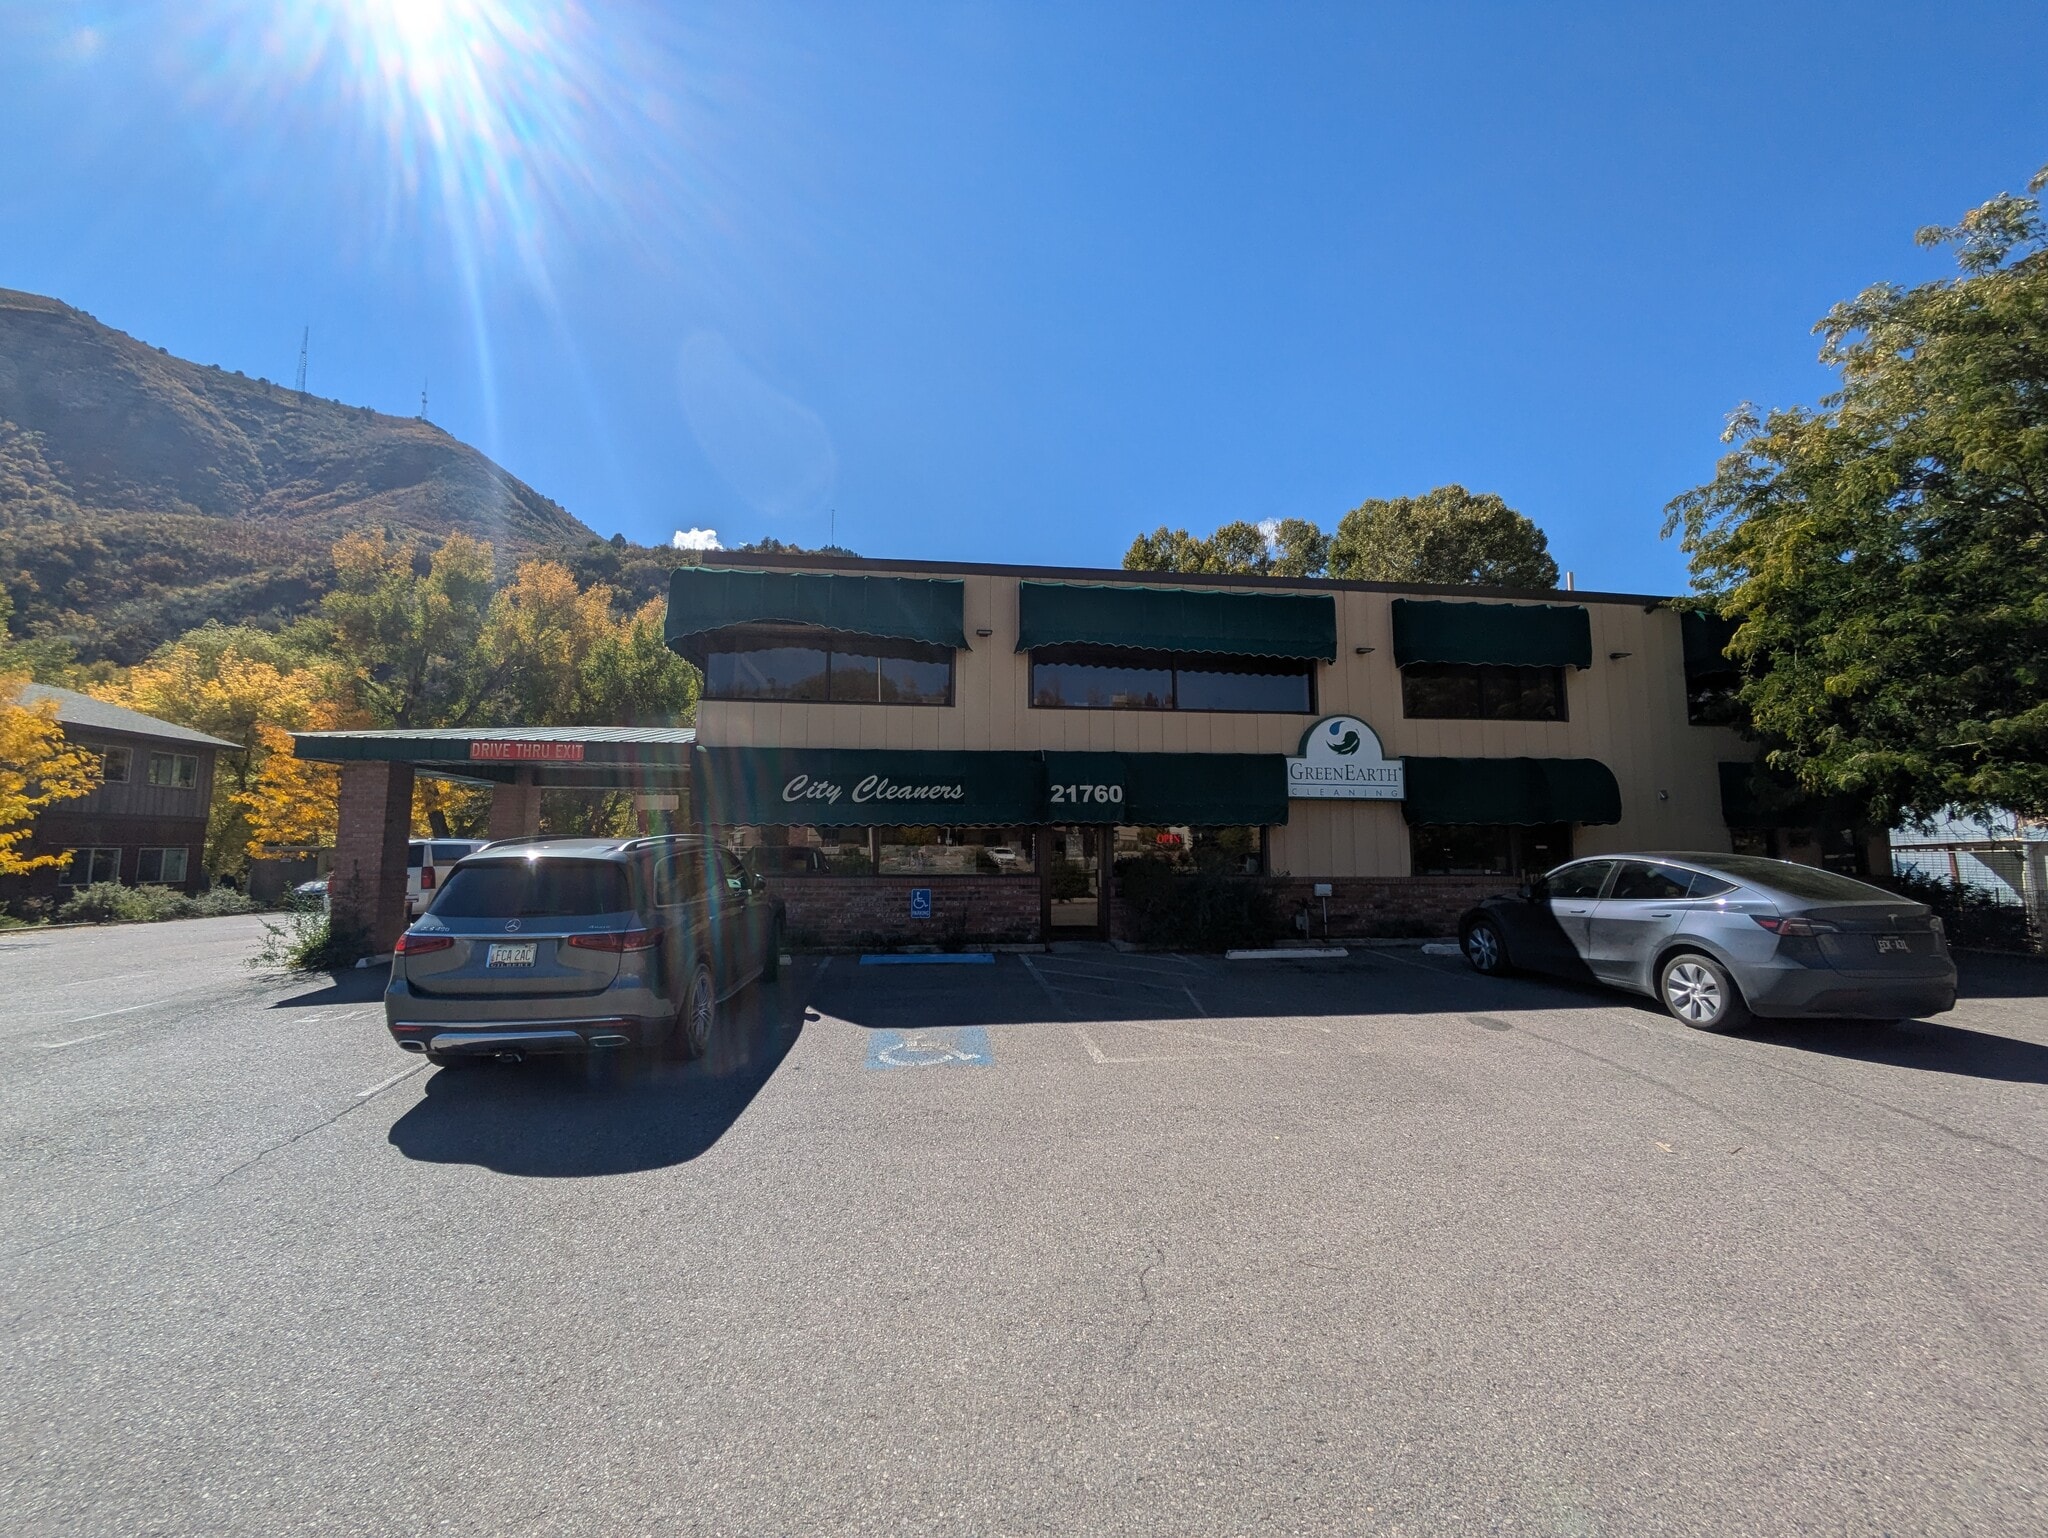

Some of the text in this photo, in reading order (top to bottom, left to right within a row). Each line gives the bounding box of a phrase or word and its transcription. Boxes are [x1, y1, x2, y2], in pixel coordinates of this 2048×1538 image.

[472, 742, 583, 759] DRIVE THRU EXIT
[782, 774, 965, 804] City Cleaners
[1050, 784, 1123, 803] 21760
[1291, 788, 1398, 797] CLEANING
[1156, 833, 1180, 844] OPEN
[495, 949, 532, 961] FCA 2AC
